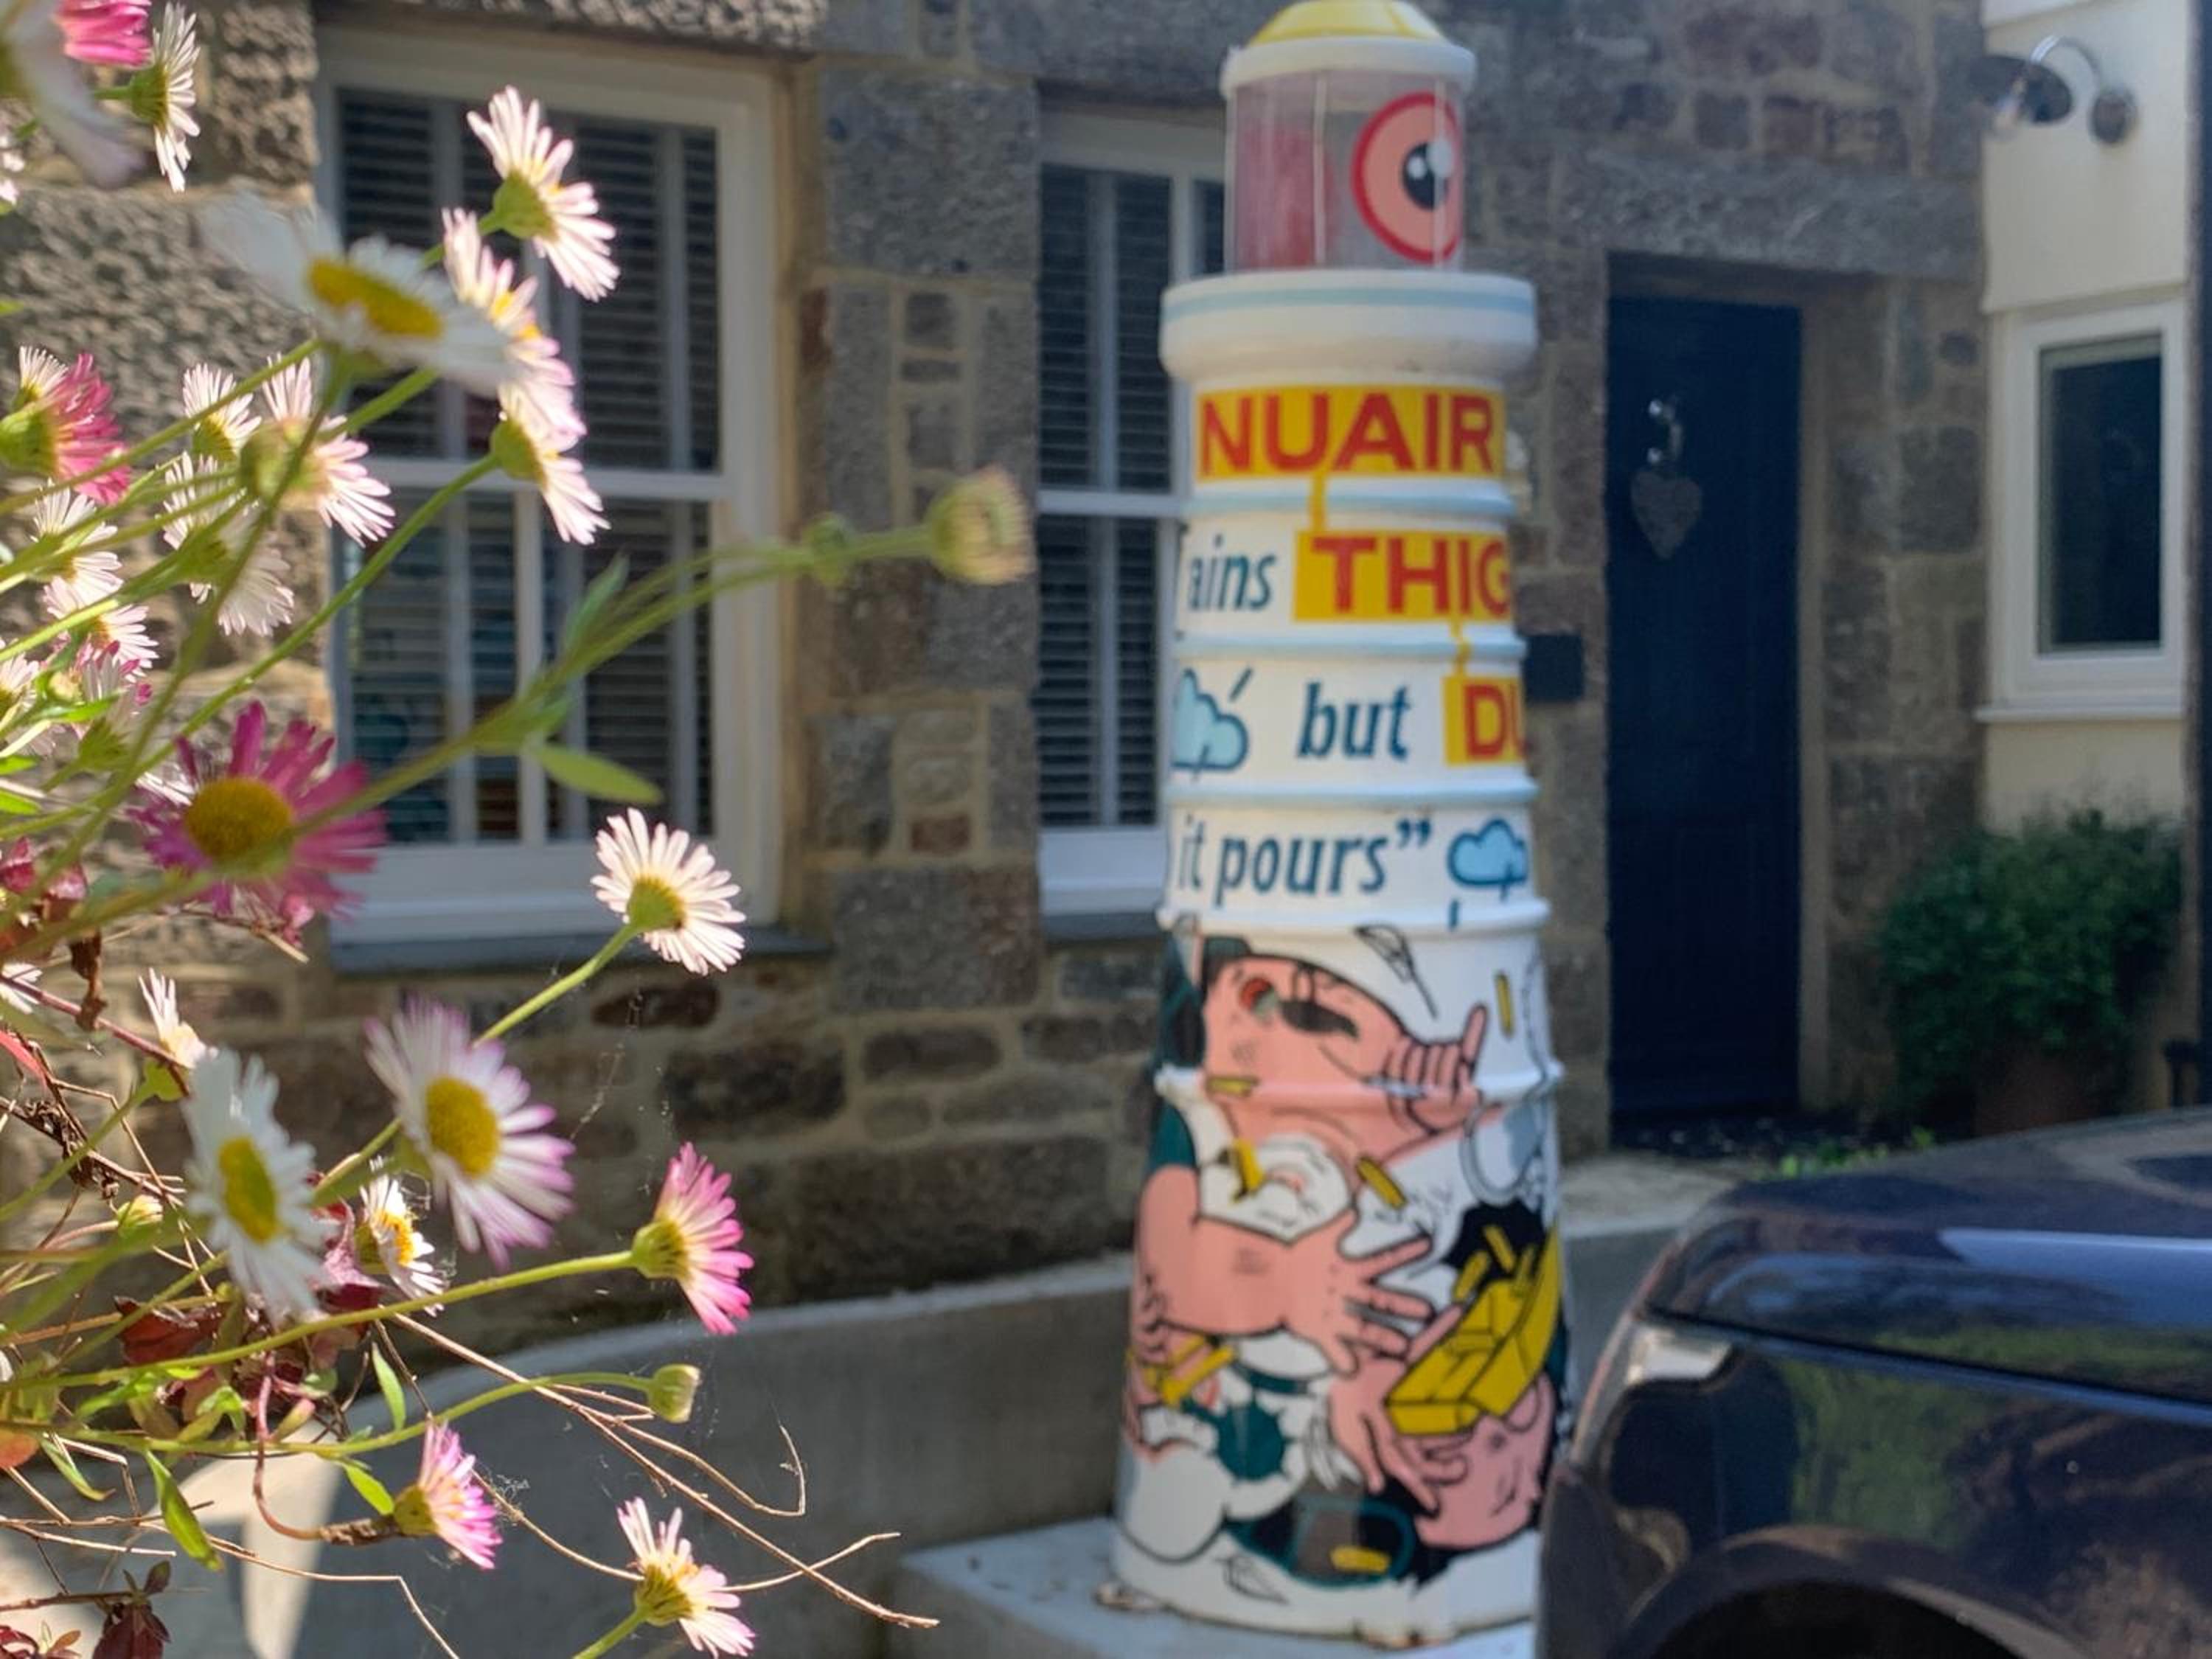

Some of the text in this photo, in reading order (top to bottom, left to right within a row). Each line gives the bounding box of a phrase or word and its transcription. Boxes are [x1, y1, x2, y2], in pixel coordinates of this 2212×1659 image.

[1201, 392, 1495, 476] NUAIR
[1295, 681, 1411, 762] but
[1178, 813, 1205, 891] it
